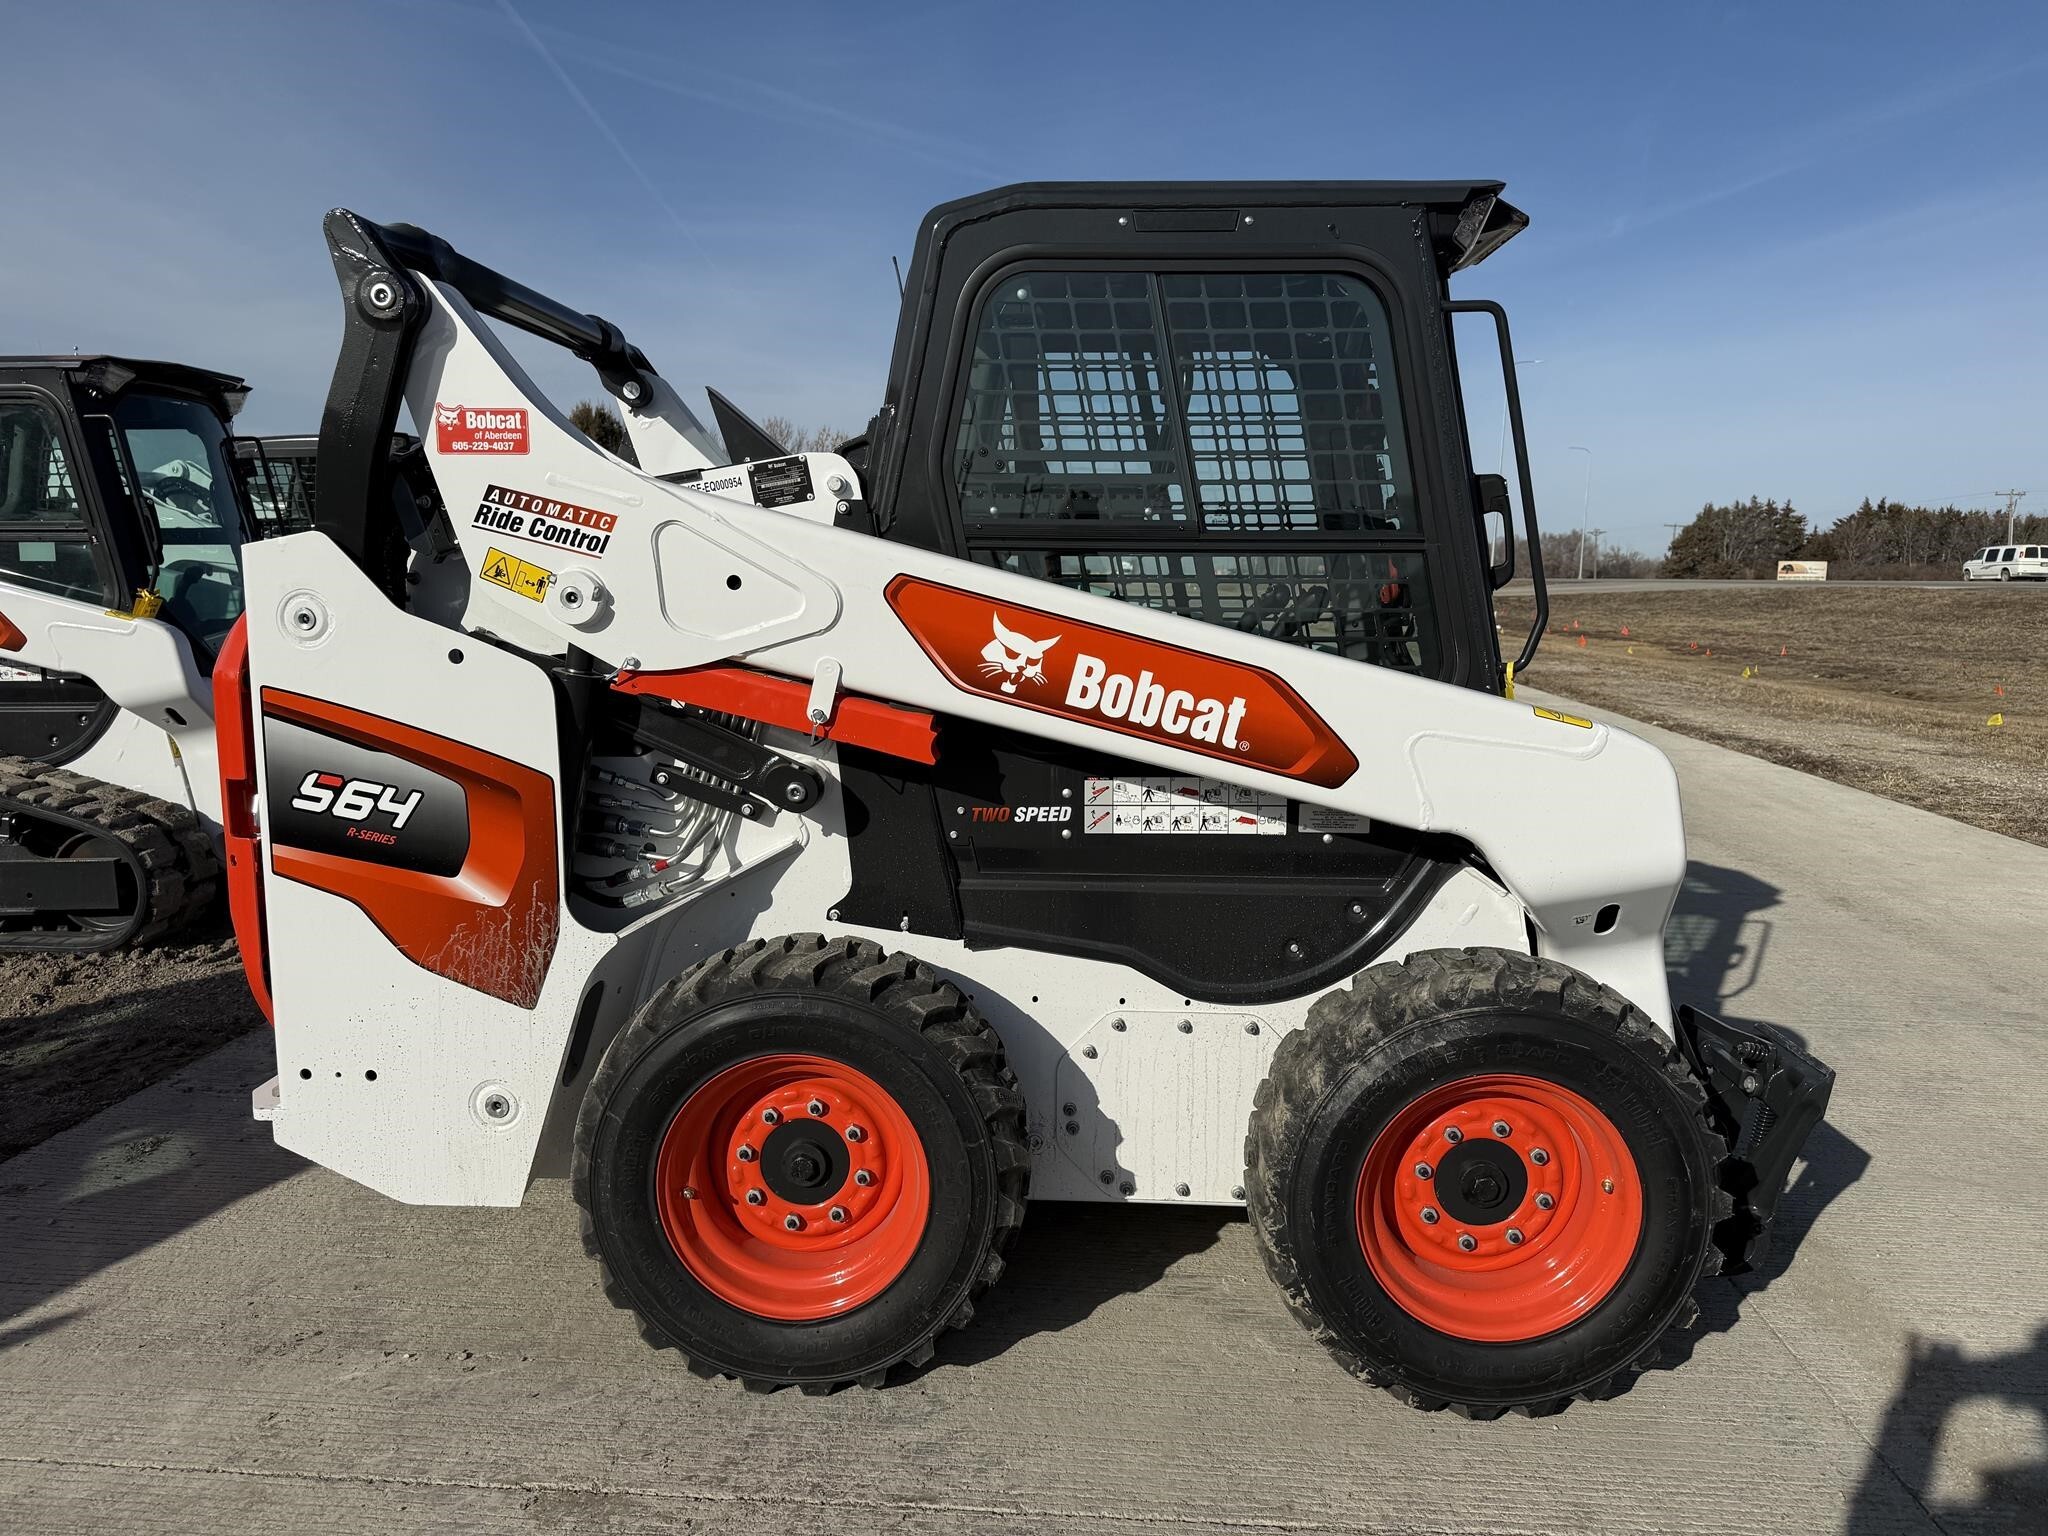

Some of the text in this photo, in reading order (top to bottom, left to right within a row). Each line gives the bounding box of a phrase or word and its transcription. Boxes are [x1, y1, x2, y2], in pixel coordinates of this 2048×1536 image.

[465, 411, 522, 429] Bobcat
[474, 430, 523, 440] of Aberdeen
[451, 441, 514, 451] 605-229-4037
[488, 489, 612, 530] AUTOMATIC
[474, 504, 611, 554] Ride Control
[1065, 653, 1247, 749] Bobcat
[291, 771, 423, 829] S64
[971, 806, 1072, 823] TWO SPEED
[346, 827, 398, 845] R-SERIES
